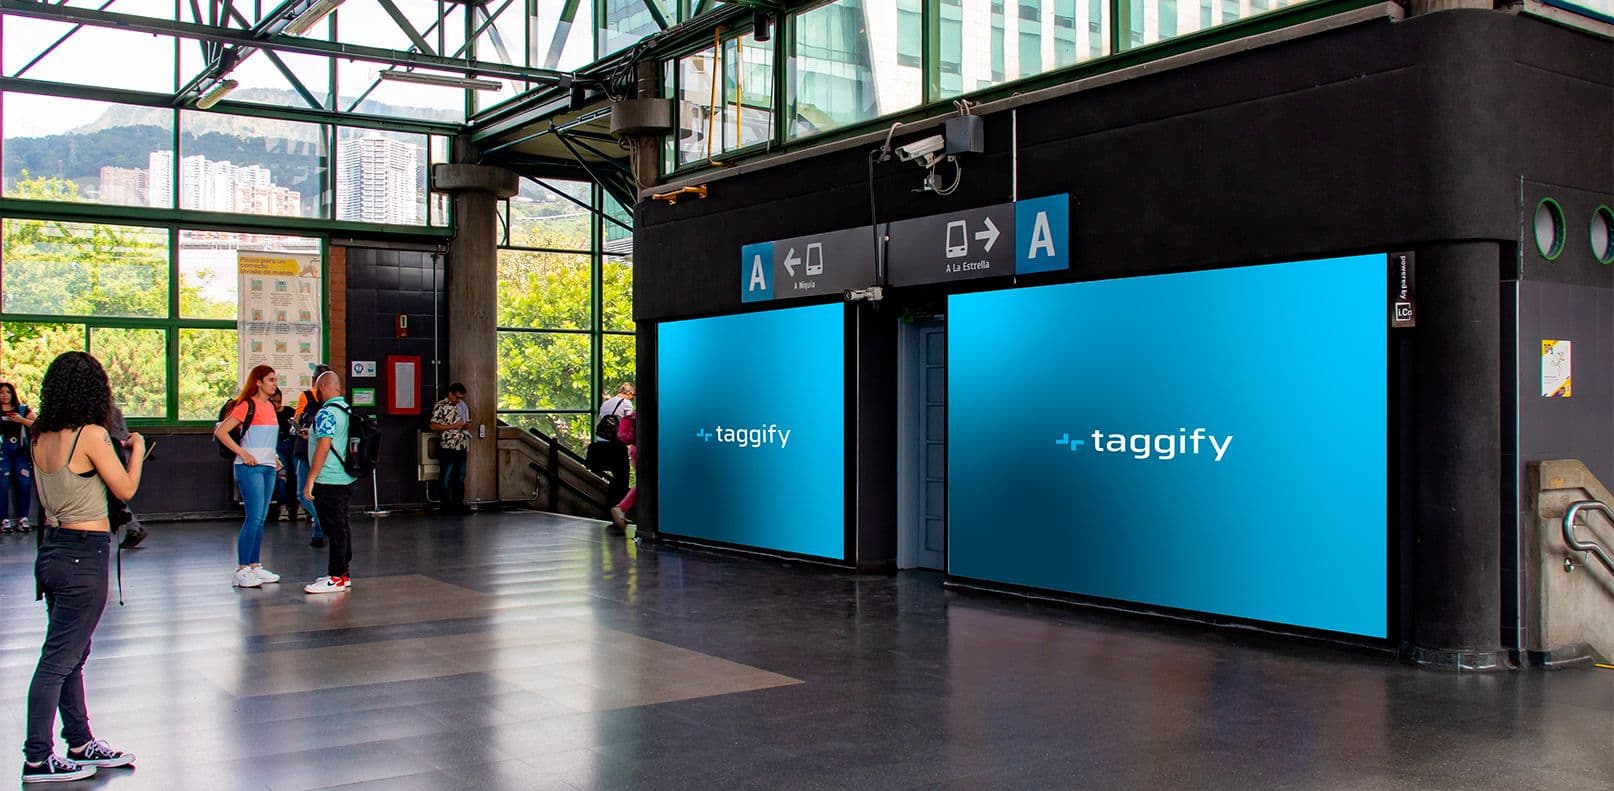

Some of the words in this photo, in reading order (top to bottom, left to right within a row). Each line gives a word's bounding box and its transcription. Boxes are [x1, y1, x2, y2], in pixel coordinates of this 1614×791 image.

[1028, 211, 1056, 259] A
[748, 254, 766, 291] A
[946, 263, 952, 273] A
[953, 263, 961, 273] La
[963, 260, 990, 271] Estrella
[1400, 289, 1408, 299] by
[715, 423, 791, 449] taggify
[1091, 427, 1233, 462] taggify
